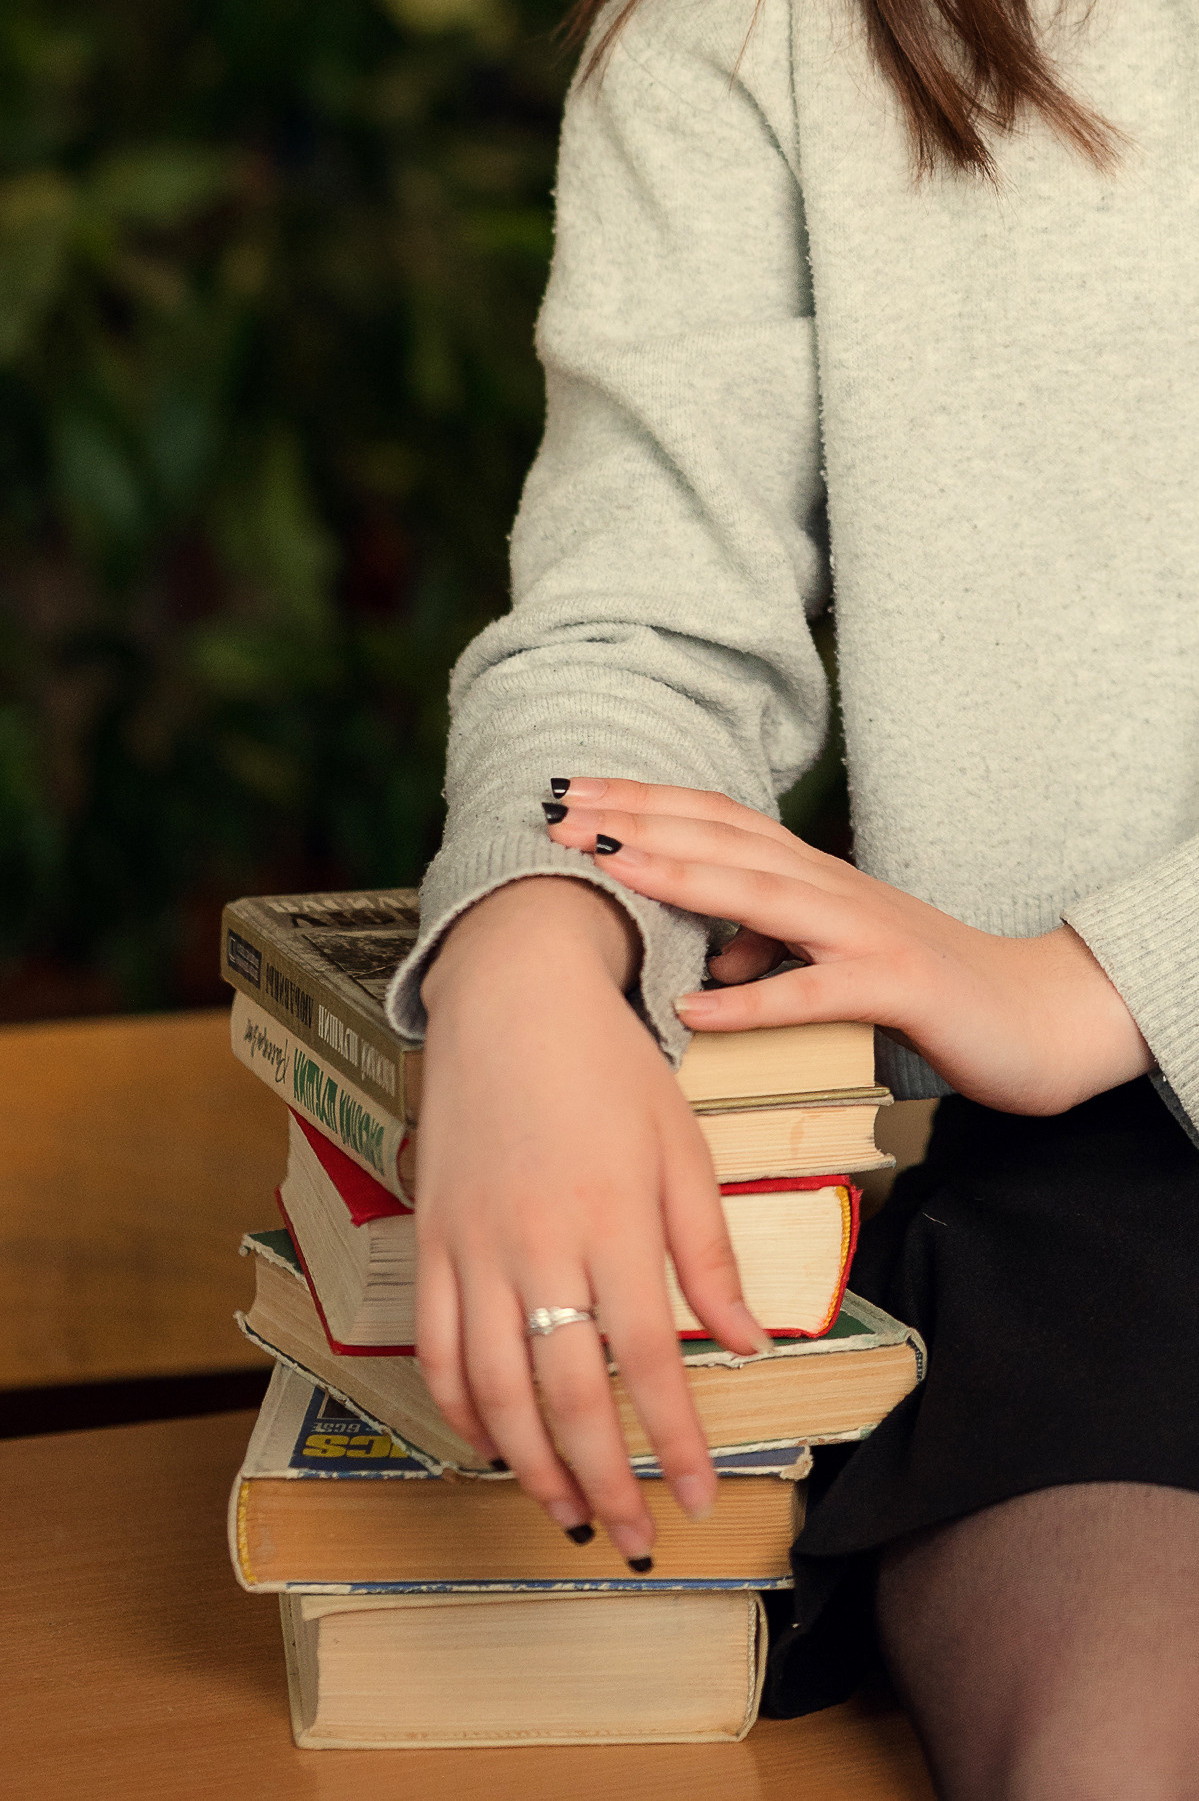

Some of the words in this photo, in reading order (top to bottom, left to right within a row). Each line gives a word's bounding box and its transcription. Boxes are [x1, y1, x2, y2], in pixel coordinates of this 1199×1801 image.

[265, 962, 314, 1029] ЛЮБАВИНЫ
[318, 1004, 360, 1068] ШУКШИН
[293, 1047, 338, 1134] ШУКШИН
[311, 1422, 361, 1434] GCSE
